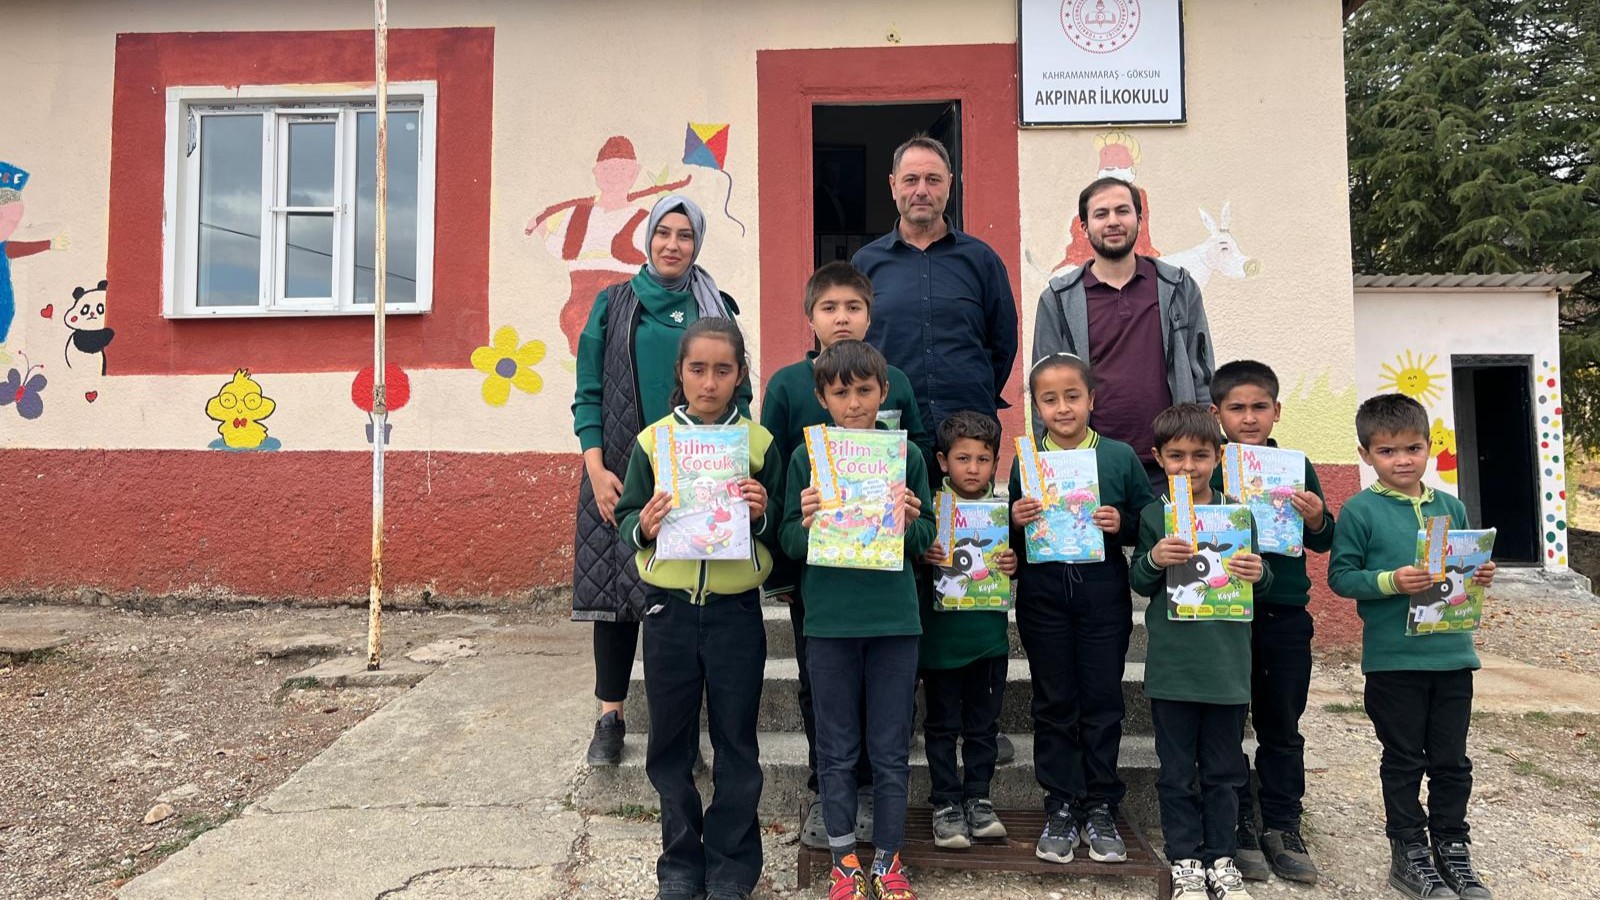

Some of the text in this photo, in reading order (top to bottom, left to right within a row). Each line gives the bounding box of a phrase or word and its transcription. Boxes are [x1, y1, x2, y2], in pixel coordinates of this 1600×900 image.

[1042, 70, 1120, 81] KAHRAMANMARAŞ
[1126, 69, 1161, 79] GÖKSUN
[1035, 86, 1169, 106] AKPINAR İLKOKULU
[674, 438, 716, 455] Bilim
[829, 440, 871, 457] Bilim
[682, 456, 734, 472] Çocuk
[836, 458, 889, 475] Çocuk
